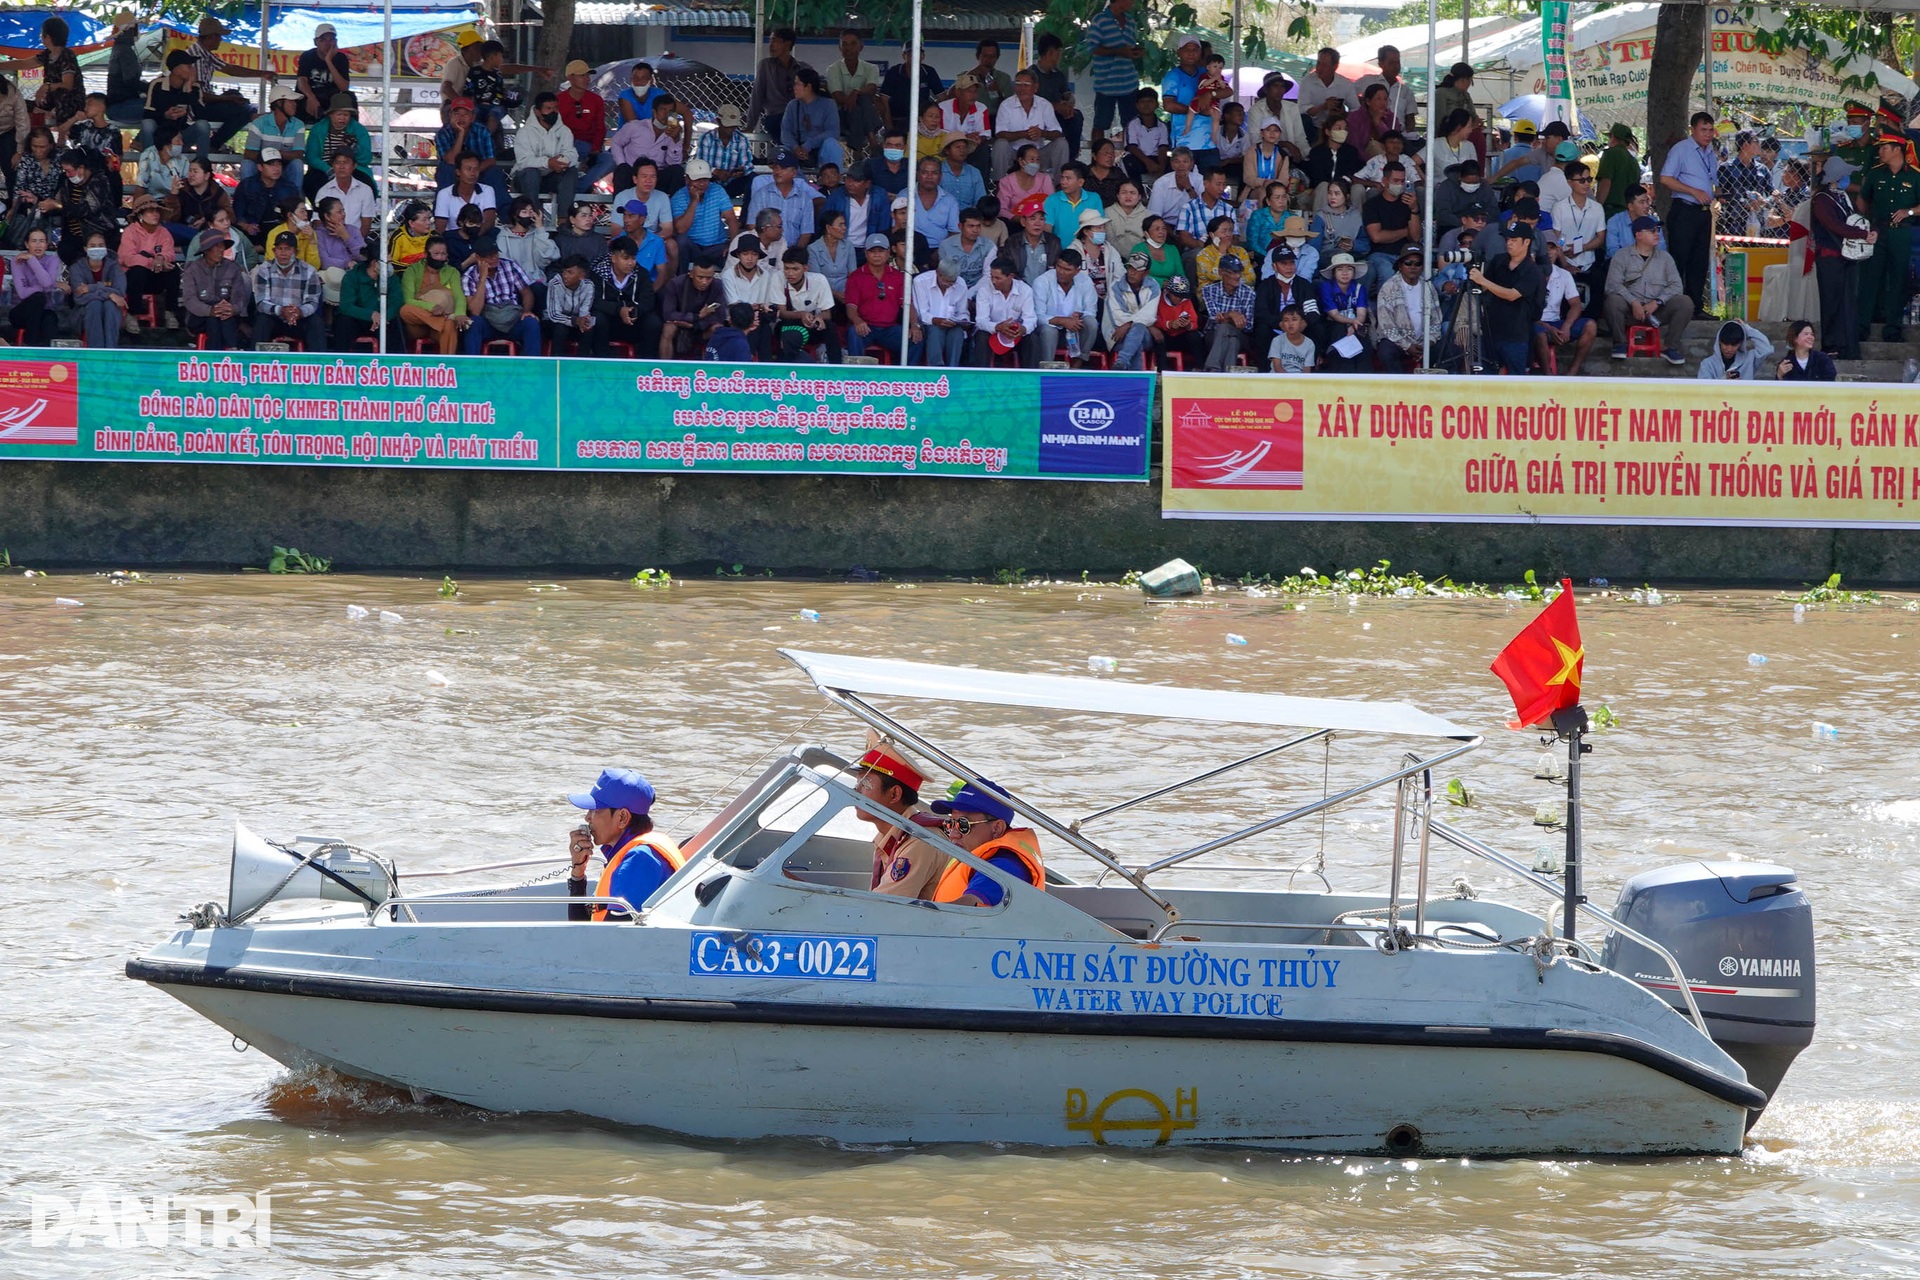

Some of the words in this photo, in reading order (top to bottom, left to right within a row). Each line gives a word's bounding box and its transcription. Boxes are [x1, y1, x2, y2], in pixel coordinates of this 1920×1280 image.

[1610, 70, 1627, 87] Rạp
[1735, 61, 1757, 74] Chén
[179, 357, 210, 382] BẢO
[213, 357, 247, 385] TỒN,
[251, 360, 289, 384] PHÁT
[292, 363, 321, 385] HUY
[324, 359, 355, 385] BẢN
[359, 359, 389, 386] SẮC
[392, 363, 423, 388] VĂN
[426, 364, 458, 388] HÓA
[139, 390, 182, 417] ĐỒNG
[185, 393, 216, 418] BÀO
[219, 394, 250, 418] DÂN
[254, 394, 282, 423] TỘC
[285, 399, 338, 420] KHMER
[342, 396, 391, 422] THÀNH
[393, 395, 426, 423] PHỐ
[428, 396, 459, 423] CẦN
[462, 401, 496, 424] THƠ:
[1318, 397, 1362, 438] XÂY
[1370, 401, 1433, 446] DỰNG
[1442, 405, 1488, 440] CON
[1497, 399, 1566, 441] NGƯỜI
[1575, 400, 1622, 449] VIỆT
[1629, 408, 1682, 443] NAM
[1690, 402, 1739, 444] THỜI
[1747, 411, 1784, 452] ĐẠI
[1793, 405, 1842, 450] MỚI,
[1851, 400, 1896, 447] GẮN
[1905, 414, 1920, 448] K
[95, 426, 132, 452] BÌNH
[136, 423, 182, 455] ĐẲNG,
[184, 428, 226, 454] ĐOÀN
[229, 427, 259, 456] KẾT,
[262, 430, 292, 455] TÔN
[296, 434, 349, 459] TRỌNG,
[352, 432, 378, 461] HỘI
[381, 432, 422, 461] NHẬP
[425, 434, 446, 459] VÀ
[448, 434, 487, 459] PHÁT
[489, 431, 538, 460] TRIỂN!
[577, 439, 641, 458] សមភាព
[1042, 434, 1077, 447] NHỰA
[1465, 453, 1518, 494] GIỮA
[1527, 453, 1564, 494] GIÁ
[1572, 461, 1606, 503] TRỊ
[1614, 451, 1700, 496] TRUYỀN
[1709, 451, 1782, 498] THỐNG
[1790, 457, 1818, 498] VÀ
[1826, 455, 1863, 499] GIÁ
[1871, 466, 1904, 508] TRỊ
[697, 937, 870, 976] CA83-0022
[991, 940, 1075, 982] CẢNH
[1083, 945, 1138, 984] SÁT
[1146, 948, 1250, 987] ĐƯỜNG
[1259, 949, 1341, 988] THỦY
[1740, 958, 1802, 977] YAMAHA
[1032, 987, 1123, 1012] WATER
[1130, 991, 1186, 1014] WAY
[1193, 992, 1284, 1016] POLICE
[1176, 1087, 1197, 1118] H
